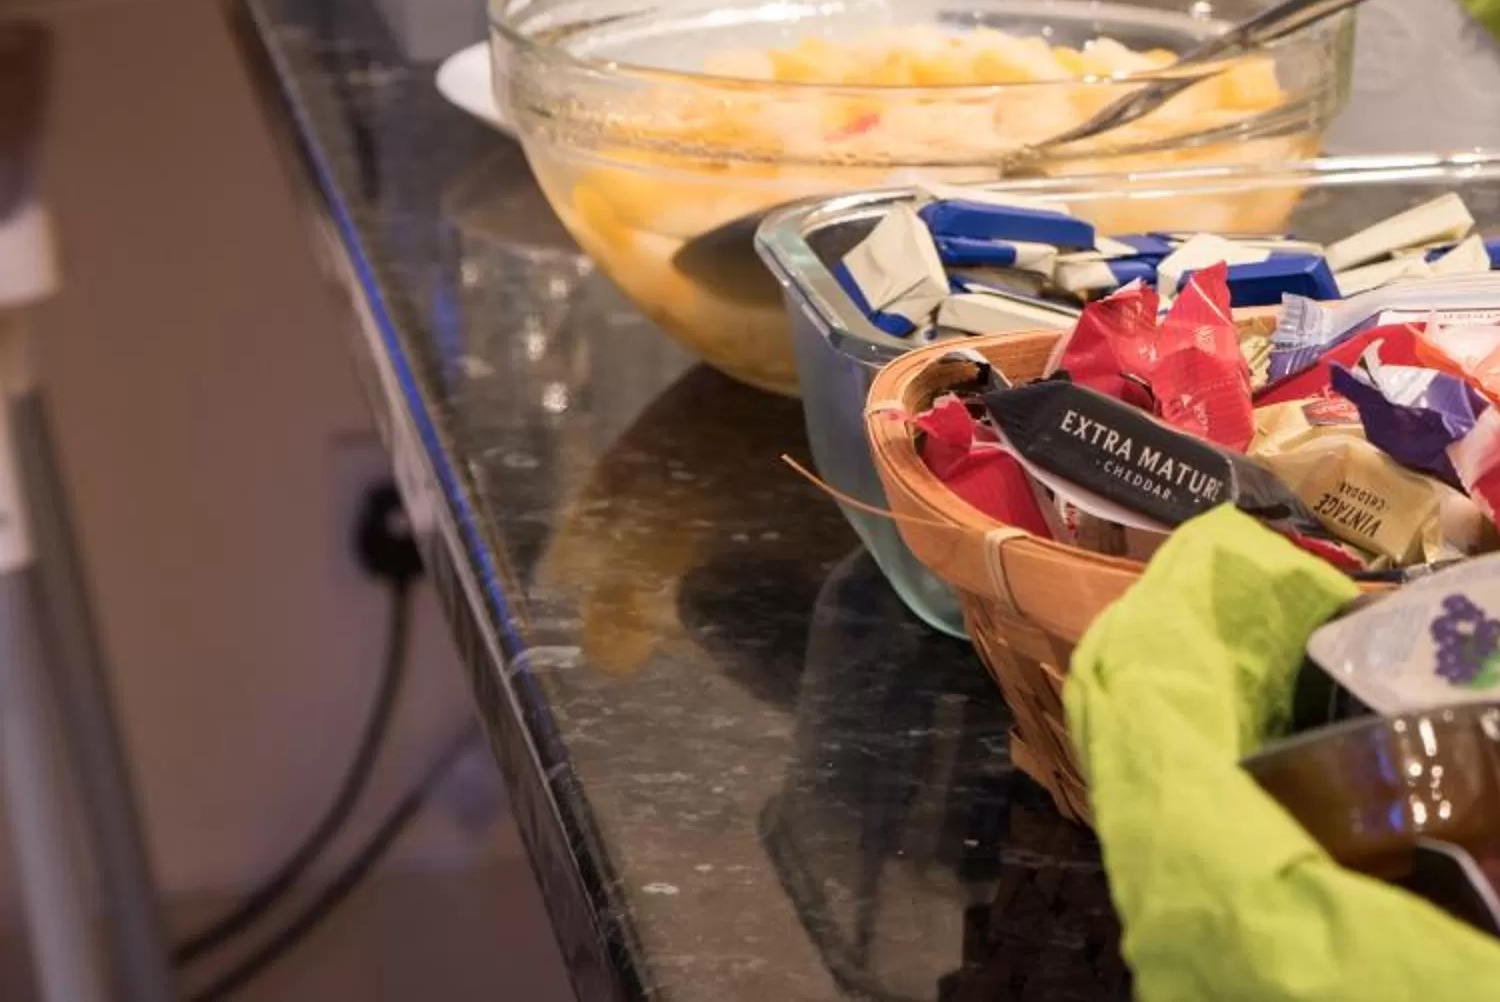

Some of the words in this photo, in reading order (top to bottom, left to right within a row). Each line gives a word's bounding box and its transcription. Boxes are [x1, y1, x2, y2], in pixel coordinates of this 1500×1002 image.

[1060, 409, 1134, 461] EXTRA
[1103, 459, 1174, 500] CHEDDAR
[1313, 493, 1382, 538] VINTAGE
